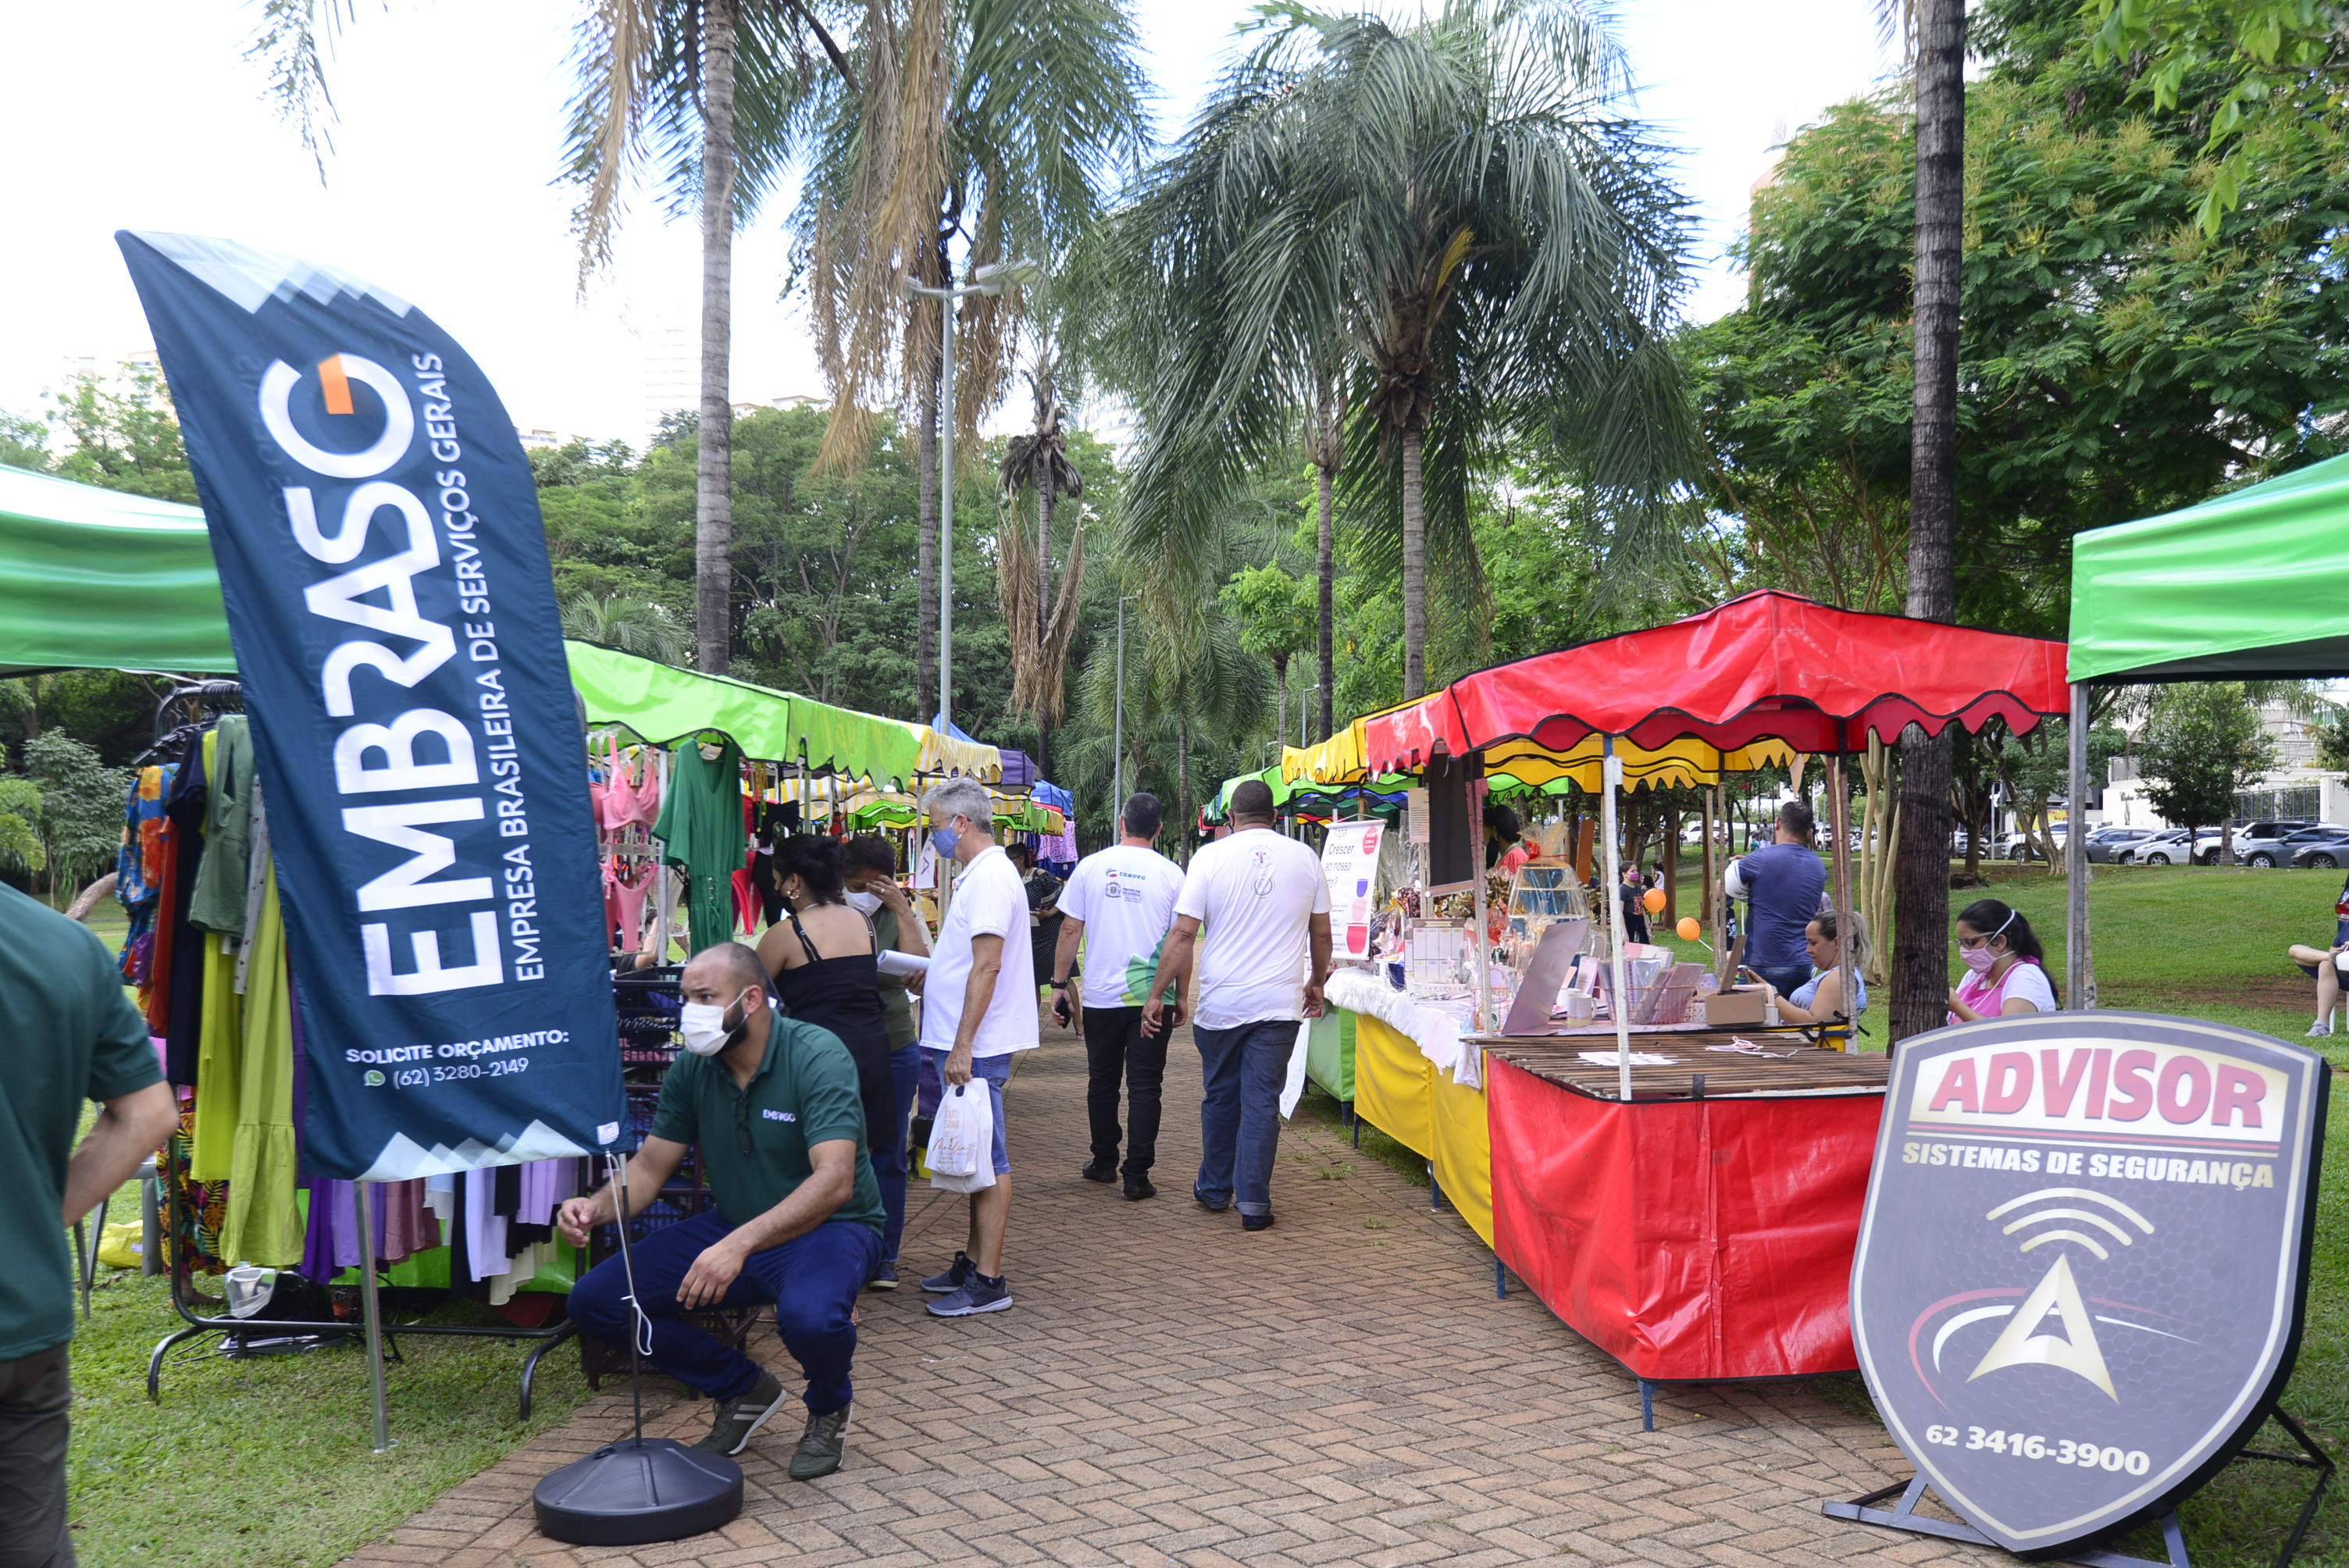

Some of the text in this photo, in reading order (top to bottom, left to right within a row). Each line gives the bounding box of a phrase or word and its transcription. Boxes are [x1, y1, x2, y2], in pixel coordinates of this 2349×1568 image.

[412, 352, 545, 982] EMPRESA BRASILEIRA DE SERVIÇOS GERAIS
[1328, 843, 1355, 855] Crescer
[1334, 861, 1352, 871] nosso
[345, 1030, 570, 1064] SOLICITE ORÇAMENTO:
[392, 1057, 529, 1090] (62) 3280-2149
[1929, 1048, 2268, 1128] ADVISOR
[1902, 1142, 2274, 1192] SISTEMAS DE SEGURANÇA
[1926, 1424, 2151, 1477] 62 3416-3900
